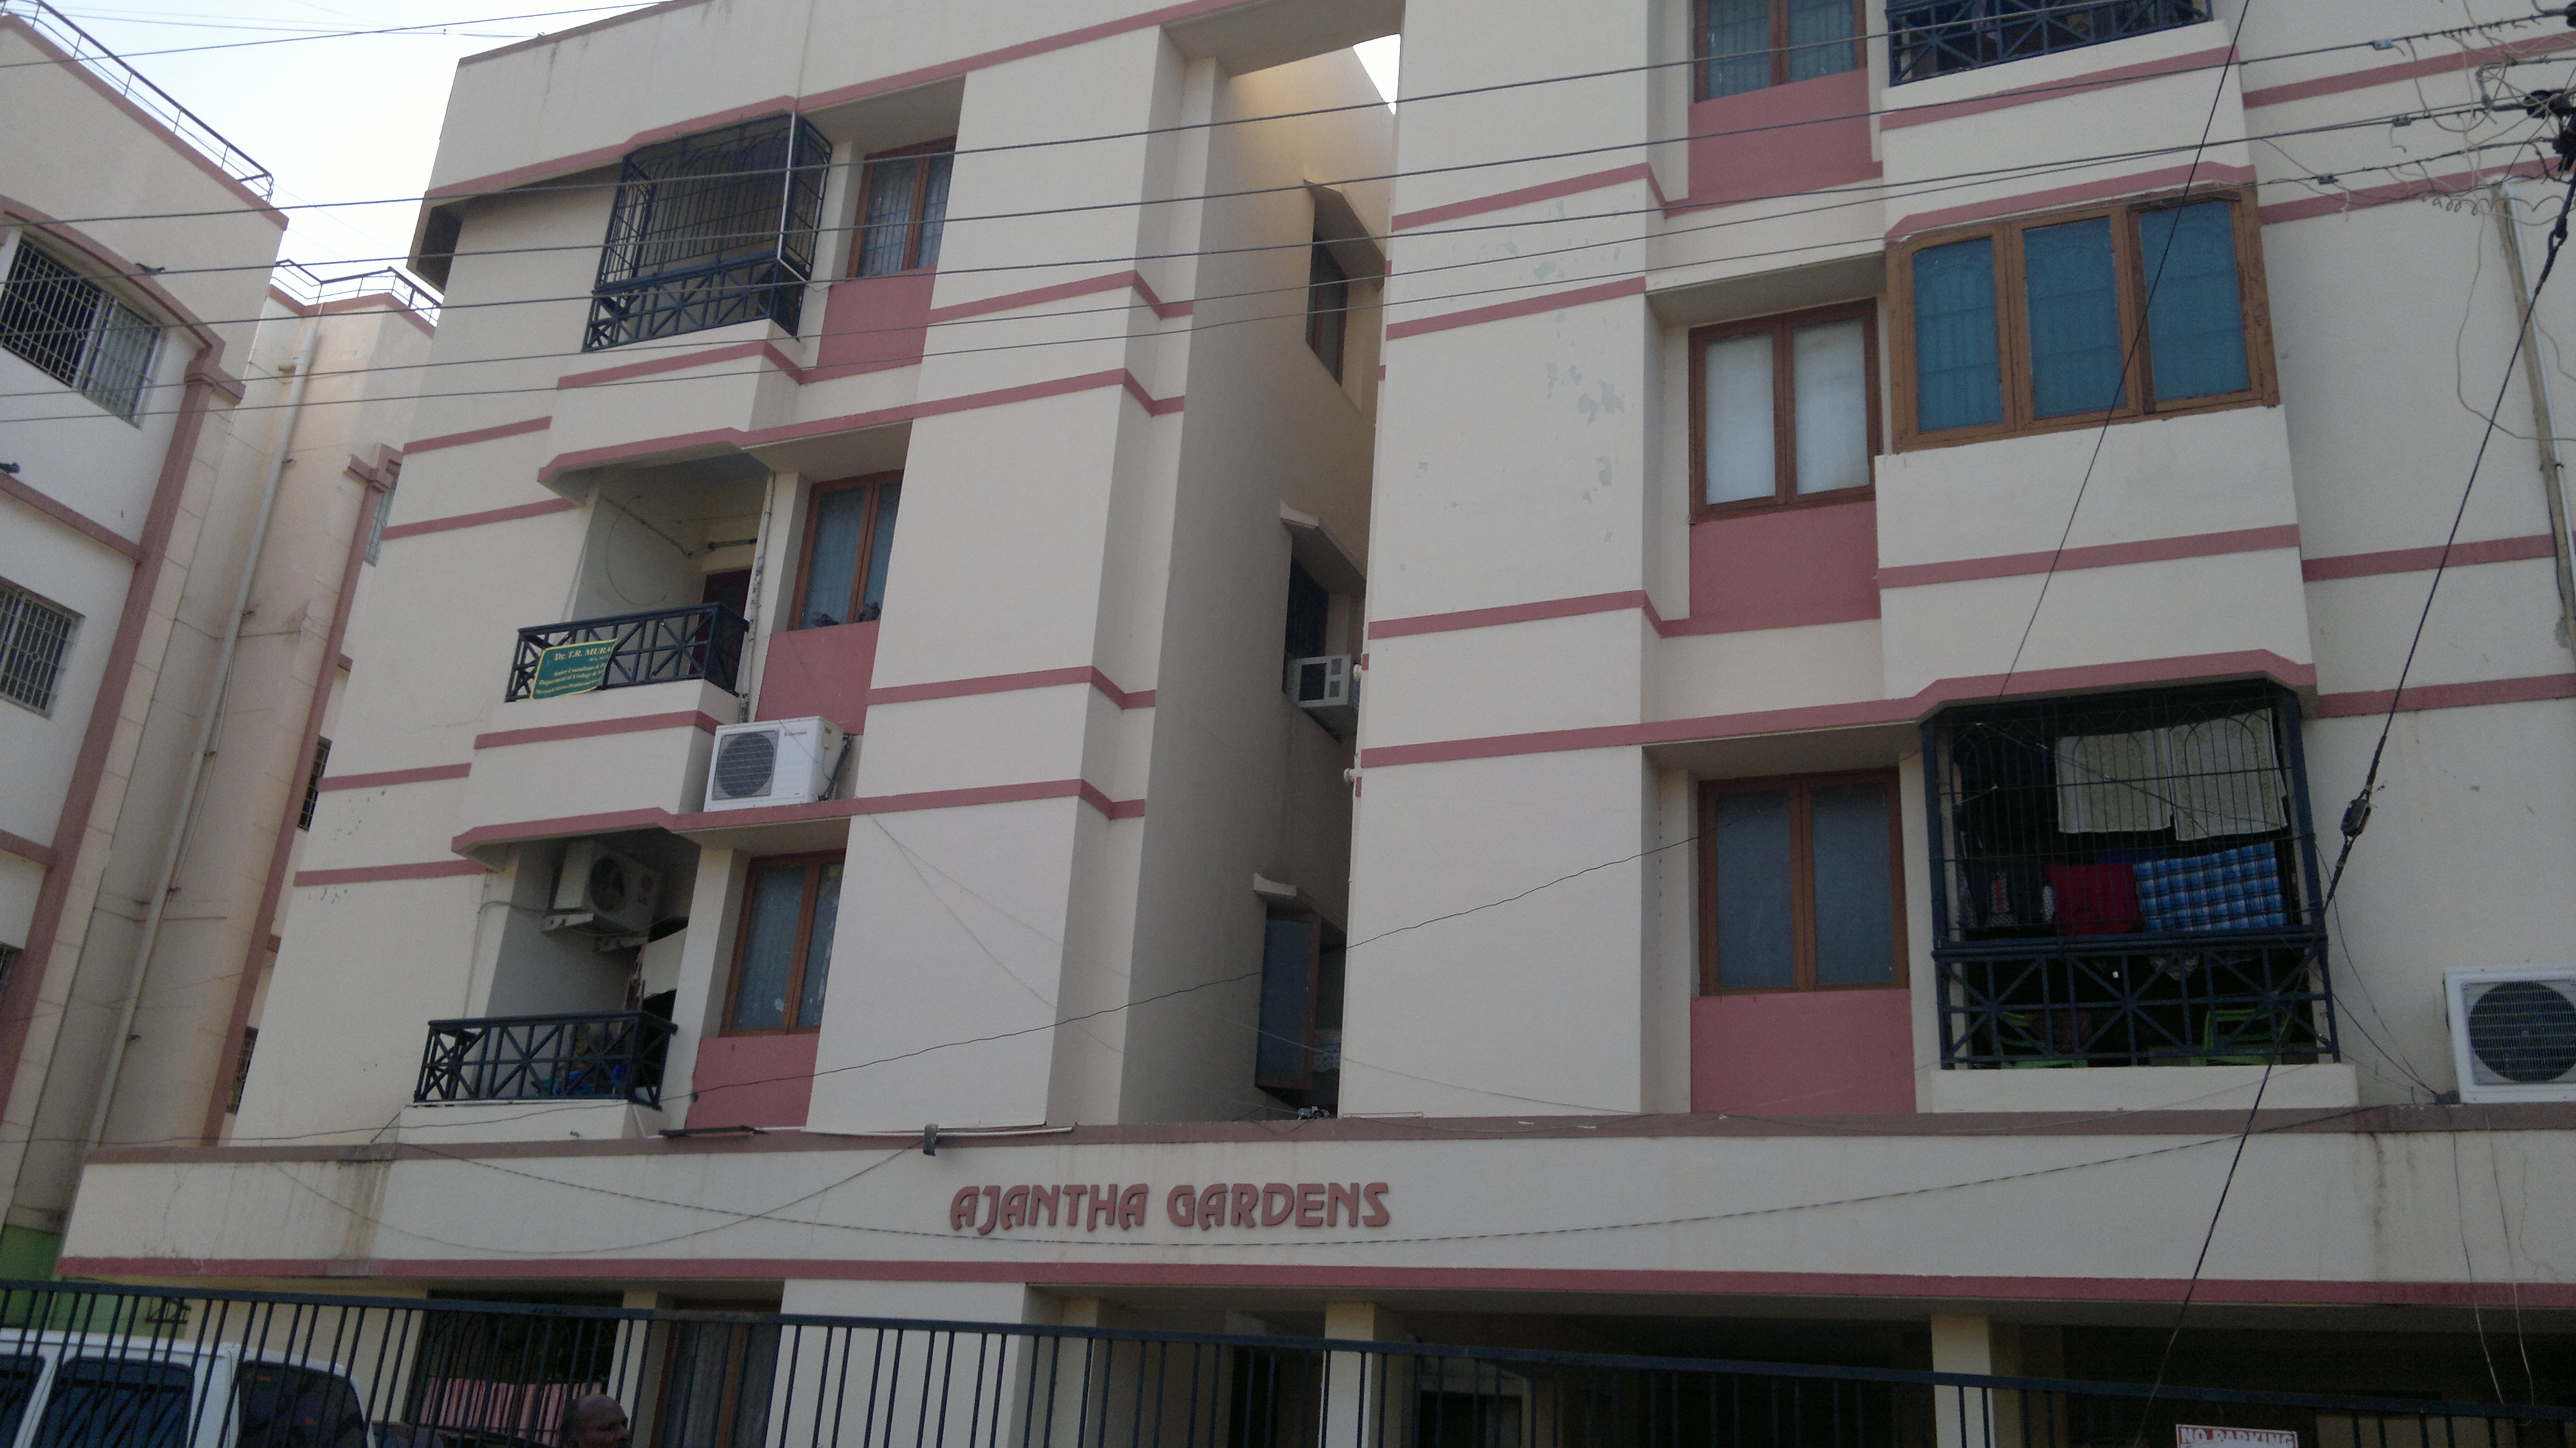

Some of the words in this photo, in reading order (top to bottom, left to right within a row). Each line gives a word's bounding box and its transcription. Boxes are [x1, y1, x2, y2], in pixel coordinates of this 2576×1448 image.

[949, 1183, 1148, 1236] AJANTHA
[1166, 1182, 1390, 1232] GARDENS
[2181, 1427, 2207, 1443] NO
[2212, 1429, 2294, 1446] PARKING
